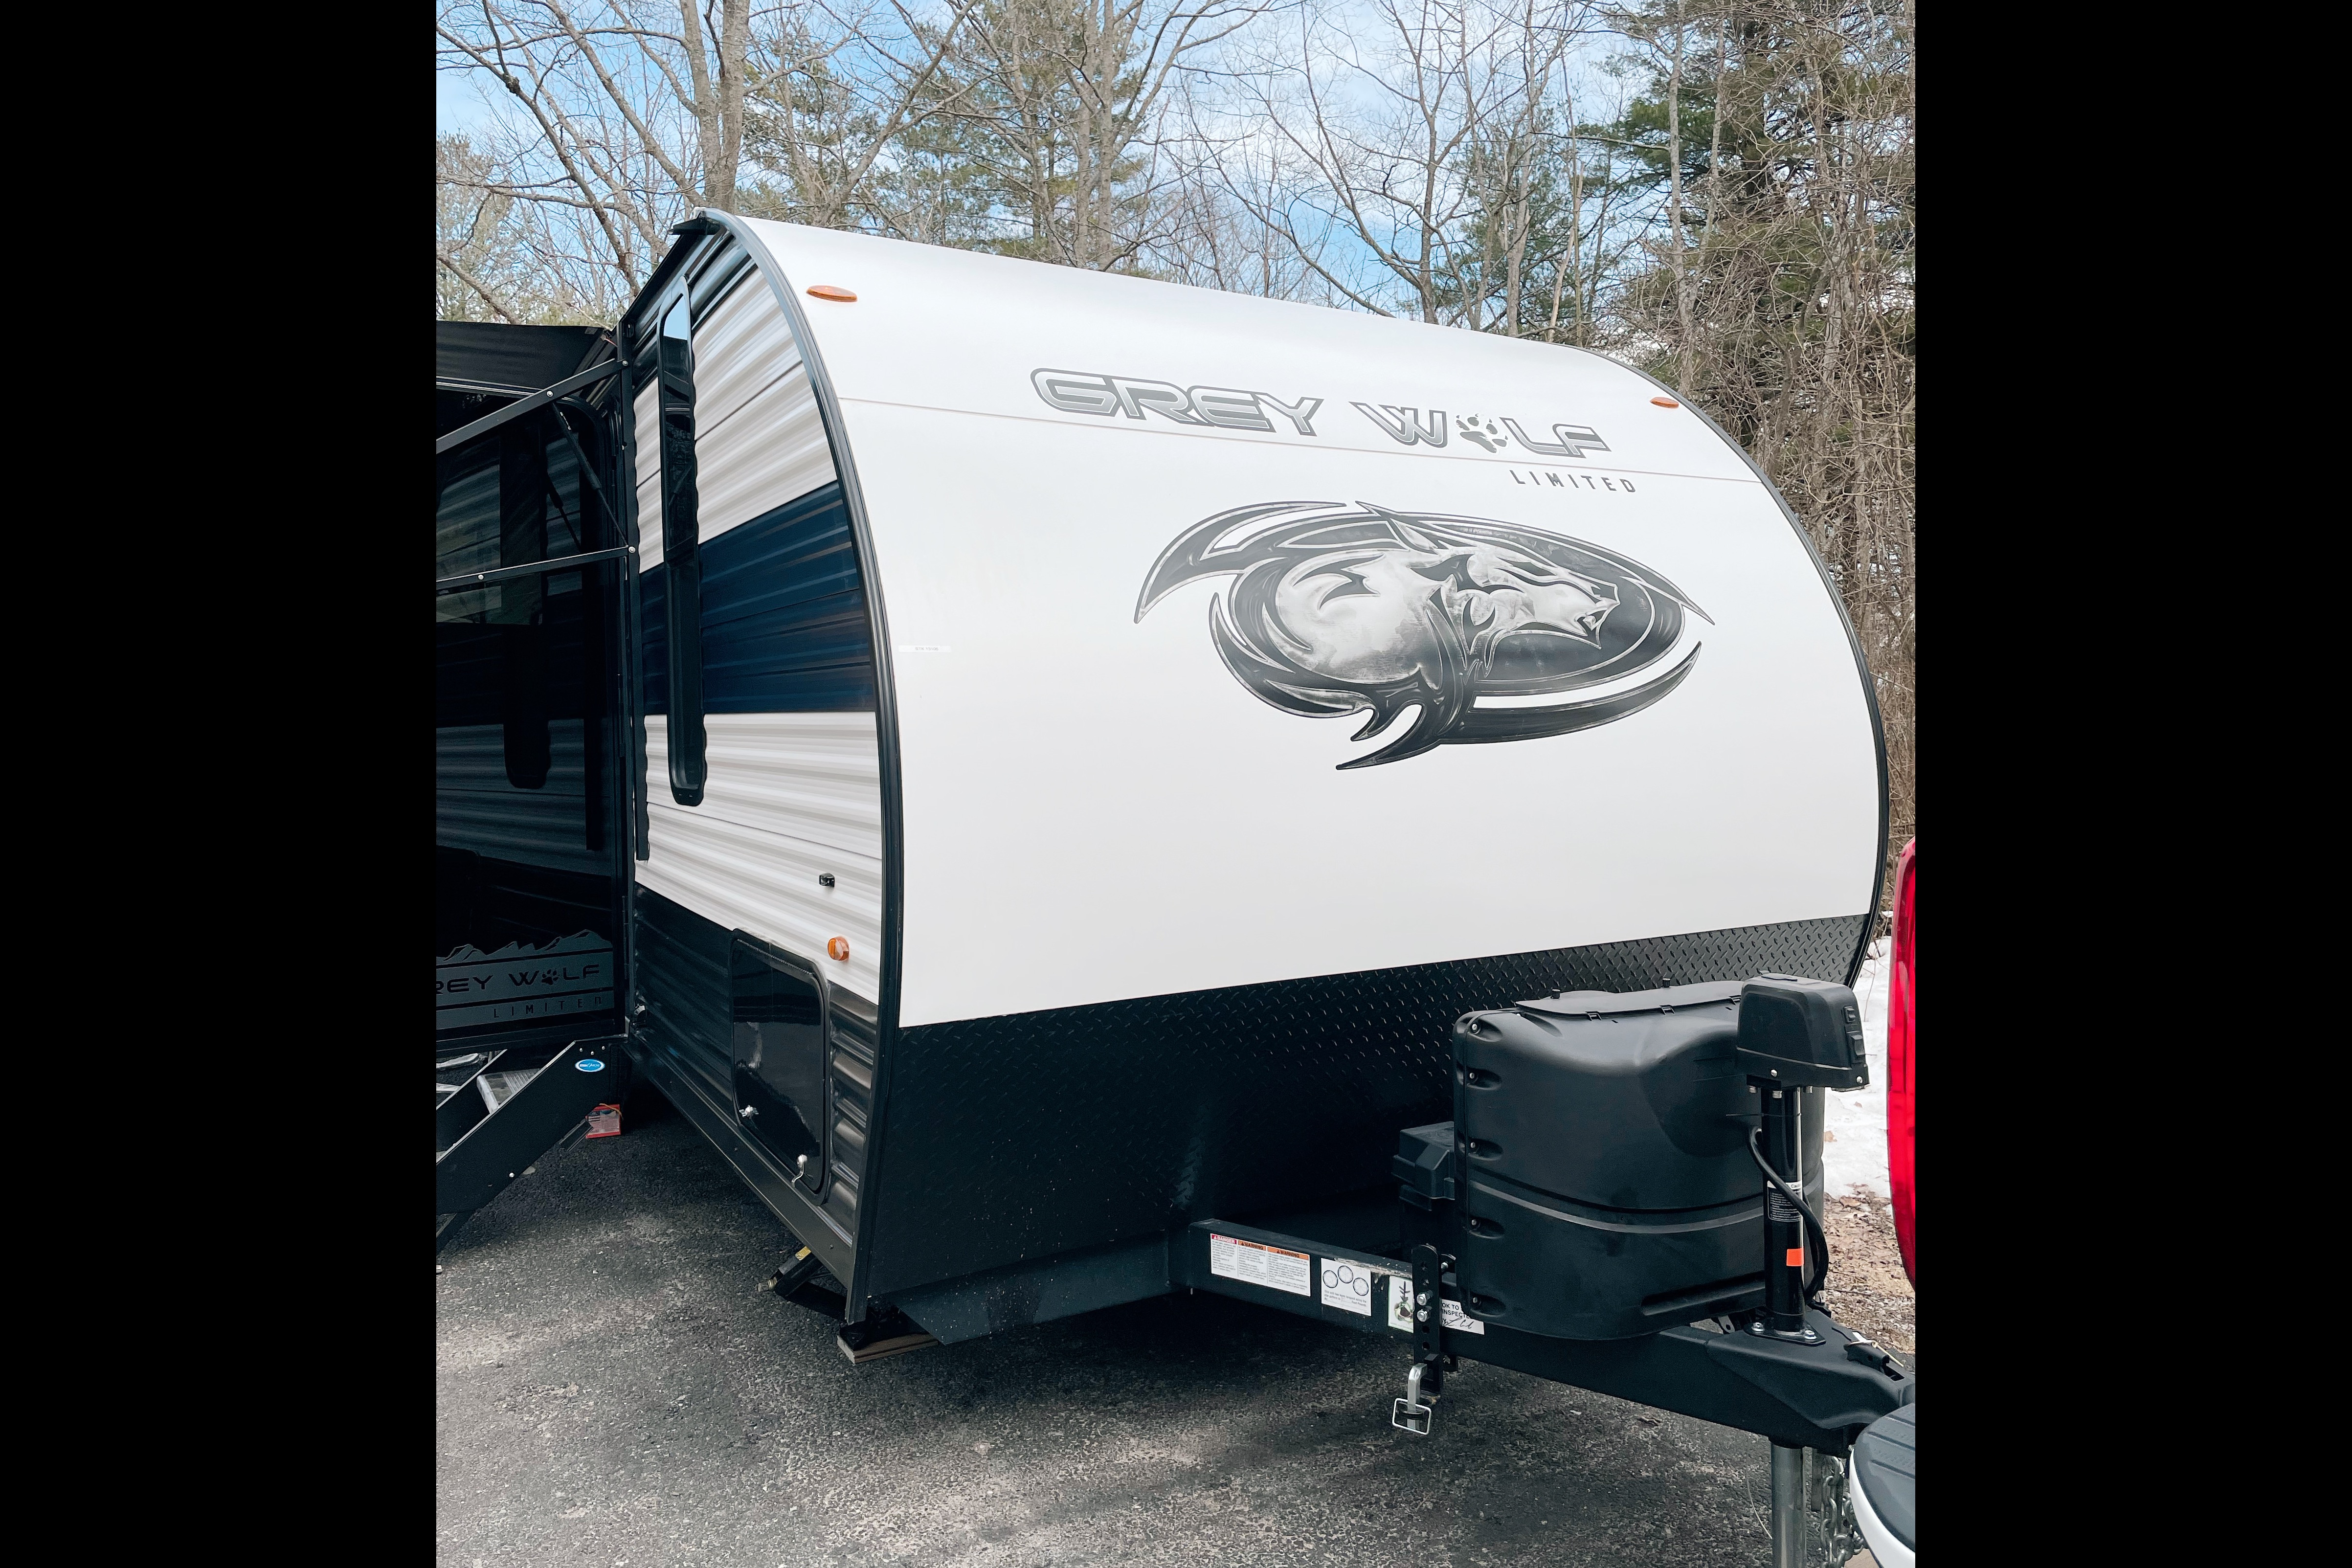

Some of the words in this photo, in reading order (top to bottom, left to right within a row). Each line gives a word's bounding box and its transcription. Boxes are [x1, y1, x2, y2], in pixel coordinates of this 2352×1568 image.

[1030, 368, 1324, 437] GREY
[1509, 470, 1635, 493] LIMITED
[493, 996, 602, 1019] LIMITED
